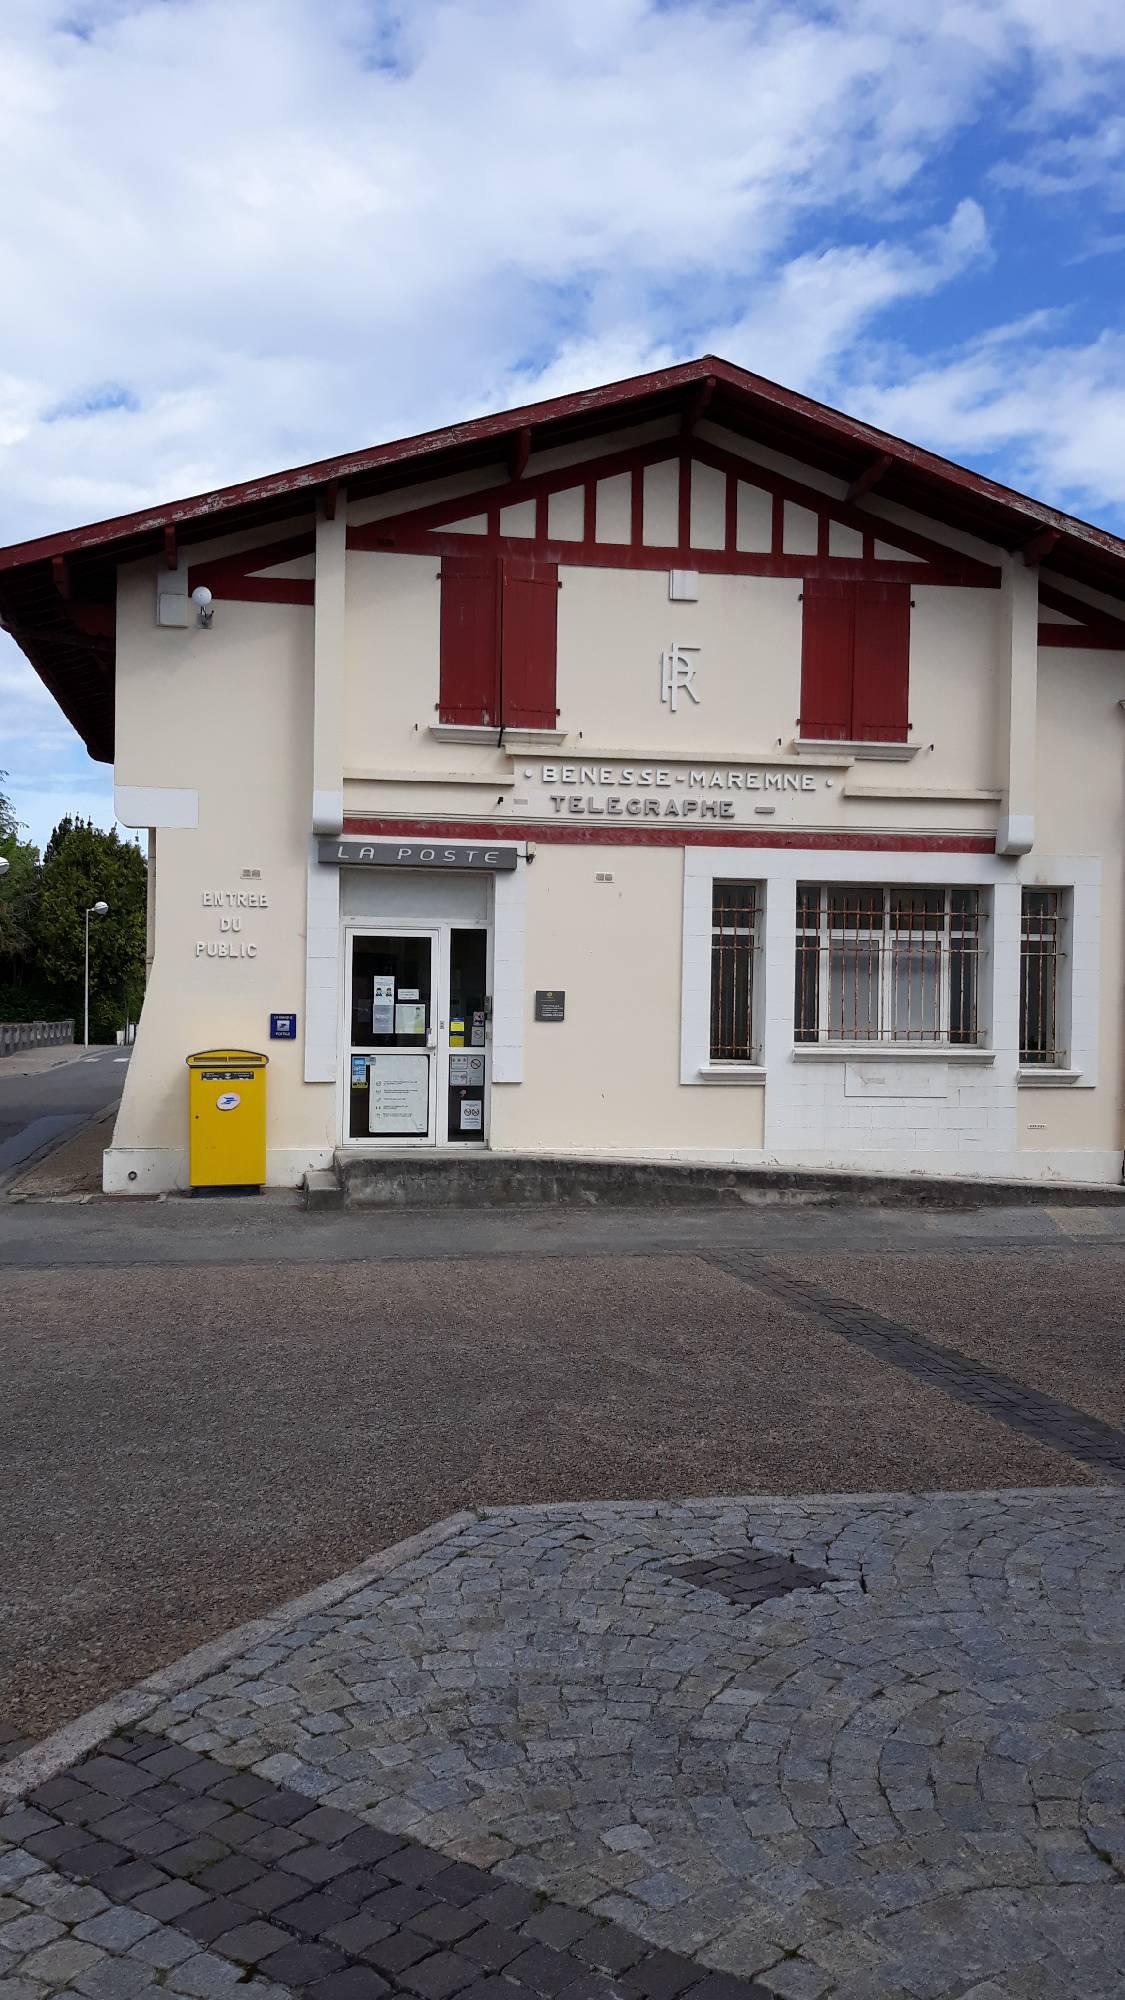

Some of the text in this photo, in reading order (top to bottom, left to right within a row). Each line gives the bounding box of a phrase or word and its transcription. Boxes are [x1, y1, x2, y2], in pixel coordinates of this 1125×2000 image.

[542, 765, 817, 791] BENESSE-MAREMNE
[550, 795, 736, 818] TELEGRAPHE
[337, 846, 500, 863] LA POSTE
[202, 891, 269, 908] ENTREE
[220, 917, 241, 932] DU
[196, 942, 257, 958] PUBLIC
